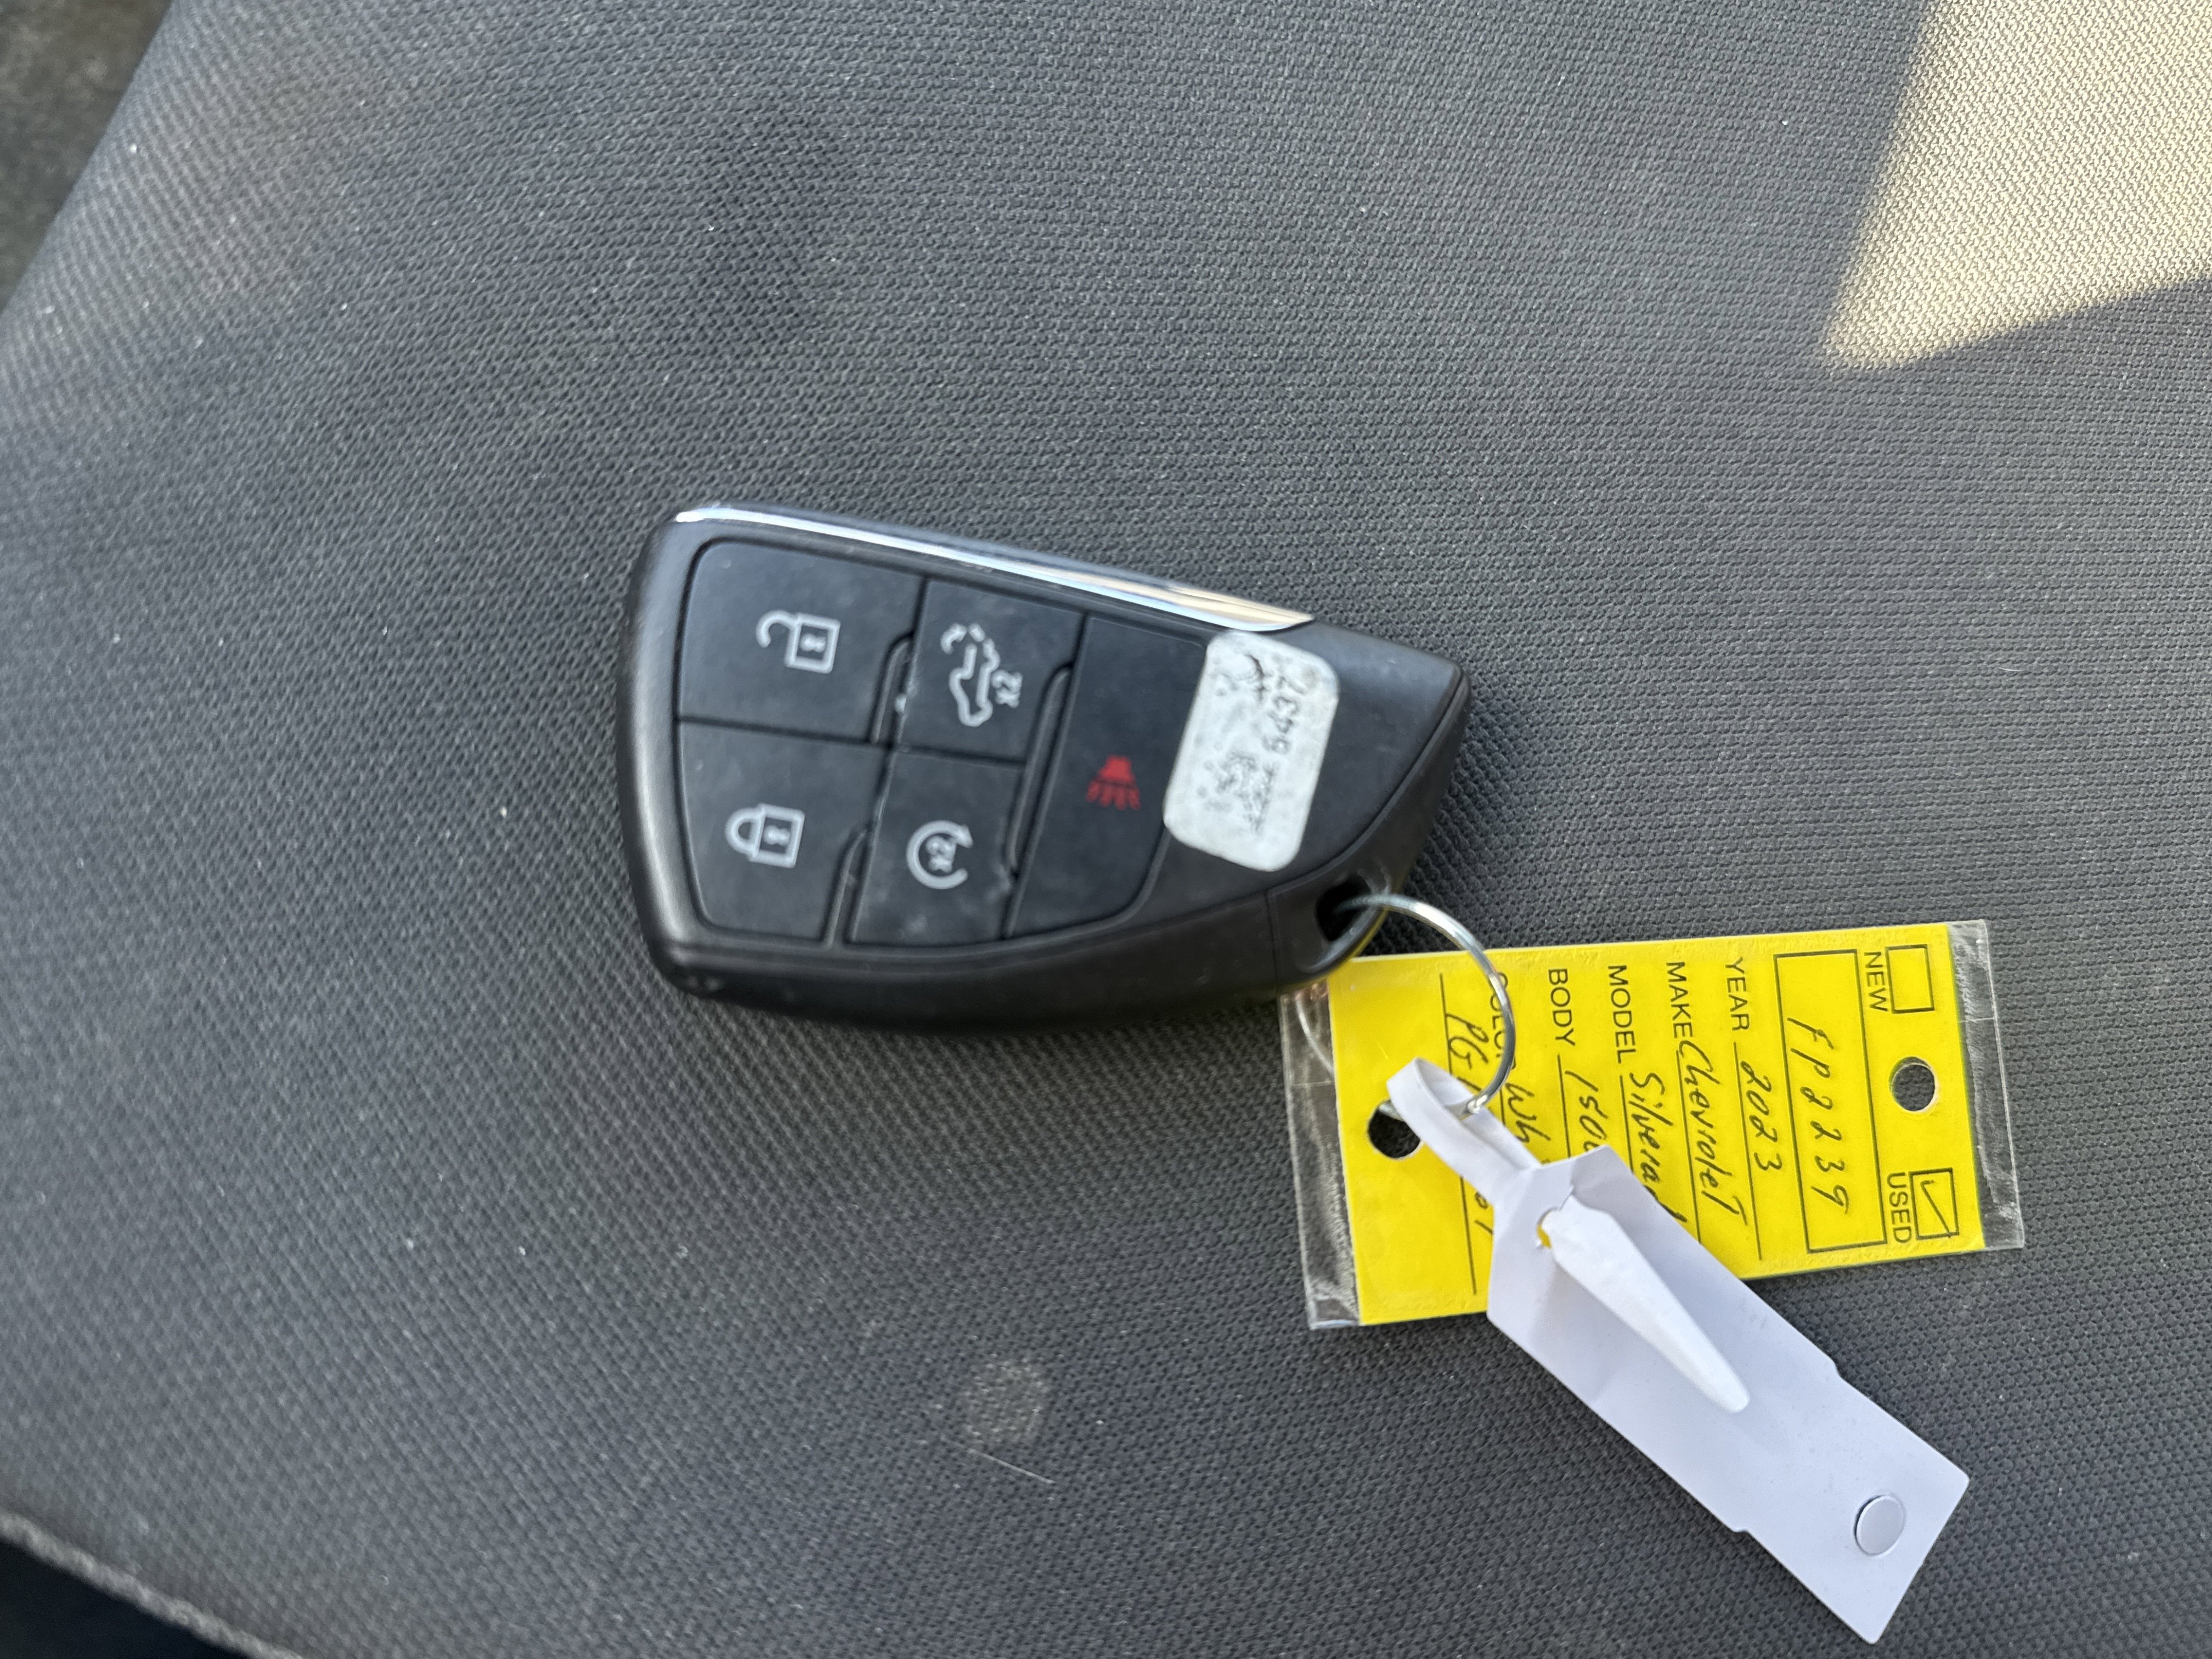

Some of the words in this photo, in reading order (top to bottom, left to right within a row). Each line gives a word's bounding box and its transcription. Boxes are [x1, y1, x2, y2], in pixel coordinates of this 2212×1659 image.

[1548, 968, 1576, 1046] BODY
[1608, 965, 1635, 1063] MODEL
[1666, 962, 1691, 1039] MAKE
[1724, 957, 1751, 1031] YEAR
[1864, 951, 1888, 1012] NEW
[1740, 1061, 1782, 1172] 2023
[1886, 1172, 1912, 1244] USED
